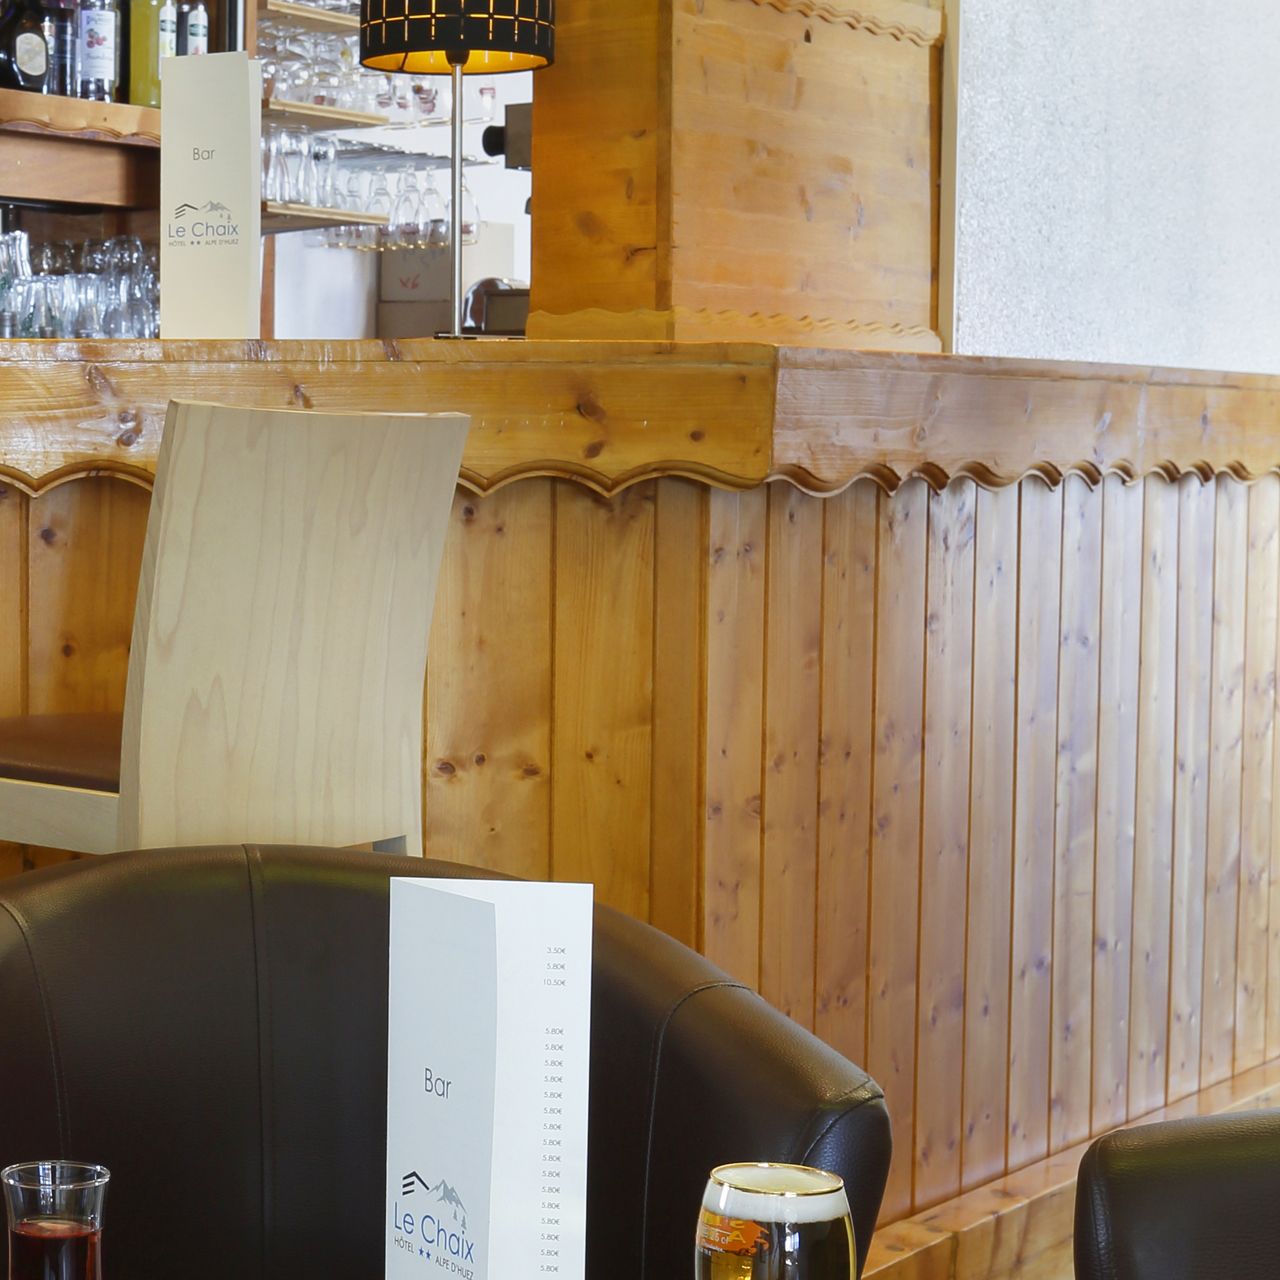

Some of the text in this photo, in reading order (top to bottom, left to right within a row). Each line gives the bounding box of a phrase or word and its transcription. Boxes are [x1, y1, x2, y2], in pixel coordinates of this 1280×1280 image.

[192, 147, 216, 161] Bar
[168, 220, 239, 239] Le Chaix
[424, 1067, 452, 1100] Bar
[394, 1201, 475, 1264] Le Chaix
[394, 1235, 415, 1254] HÔTEL
[435, 1255, 450, 1270] ALPE
